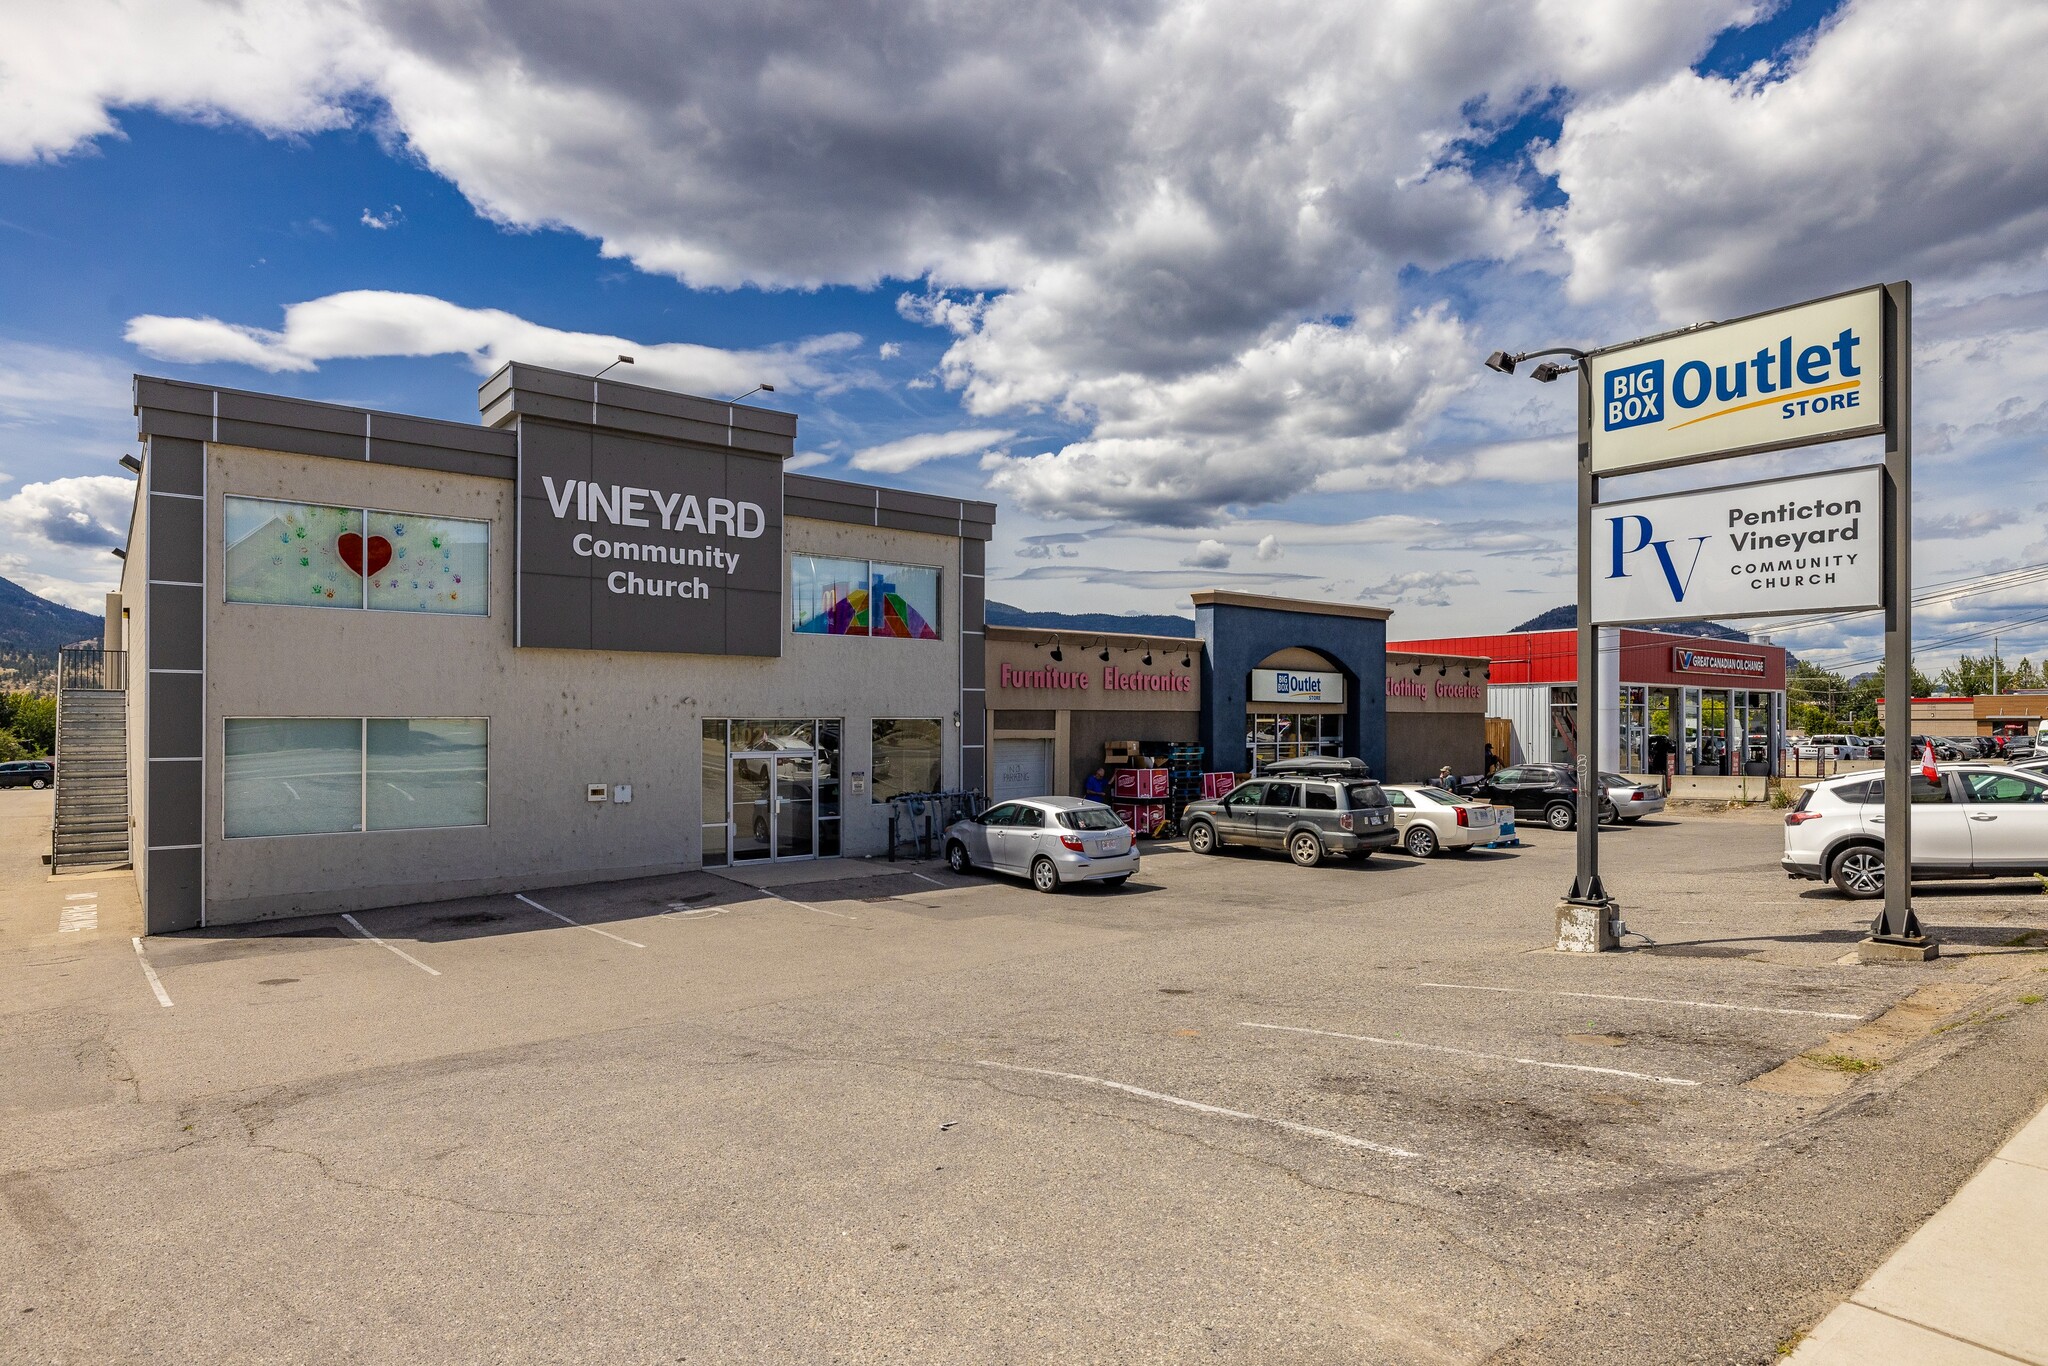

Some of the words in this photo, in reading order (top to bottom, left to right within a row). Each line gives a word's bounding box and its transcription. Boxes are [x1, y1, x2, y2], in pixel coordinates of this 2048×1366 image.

[1672, 327, 1861, 409] Outlet
[1613, 368, 1654, 399] BIG
[1609, 392, 1659, 425] BOX
[1782, 390, 1860, 420] STORE
[541, 476, 766, 539] VINEYARD
[1729, 499, 1861, 528] Penticton
[1729, 518, 1859, 552] Vineyard
[572, 533, 741, 575] Community
[1604, 514, 1713, 603] PV
[1730, 553, 1858, 575] COMMUNITY
[607, 571, 709, 600] Church
[1751, 572, 1836, 590] CHURCH
[1001, 663, 1089, 690] Furniture
[1103, 666, 1191, 692] Electronics
[1692, 655, 1710, 667] GREAT
[1709, 657, 1736, 670] CANADIAN
[1736, 659, 1744, 670] OIL
[1743, 660, 1764, 672] CHANGE
[1278, 675, 1288, 684] BIG
[1278, 683, 1289, 692] BOX
[1290, 676, 1321, 692] Outlet
[1385, 677, 1427, 701] Clothing
[1435, 679, 1481, 699] Groceries
